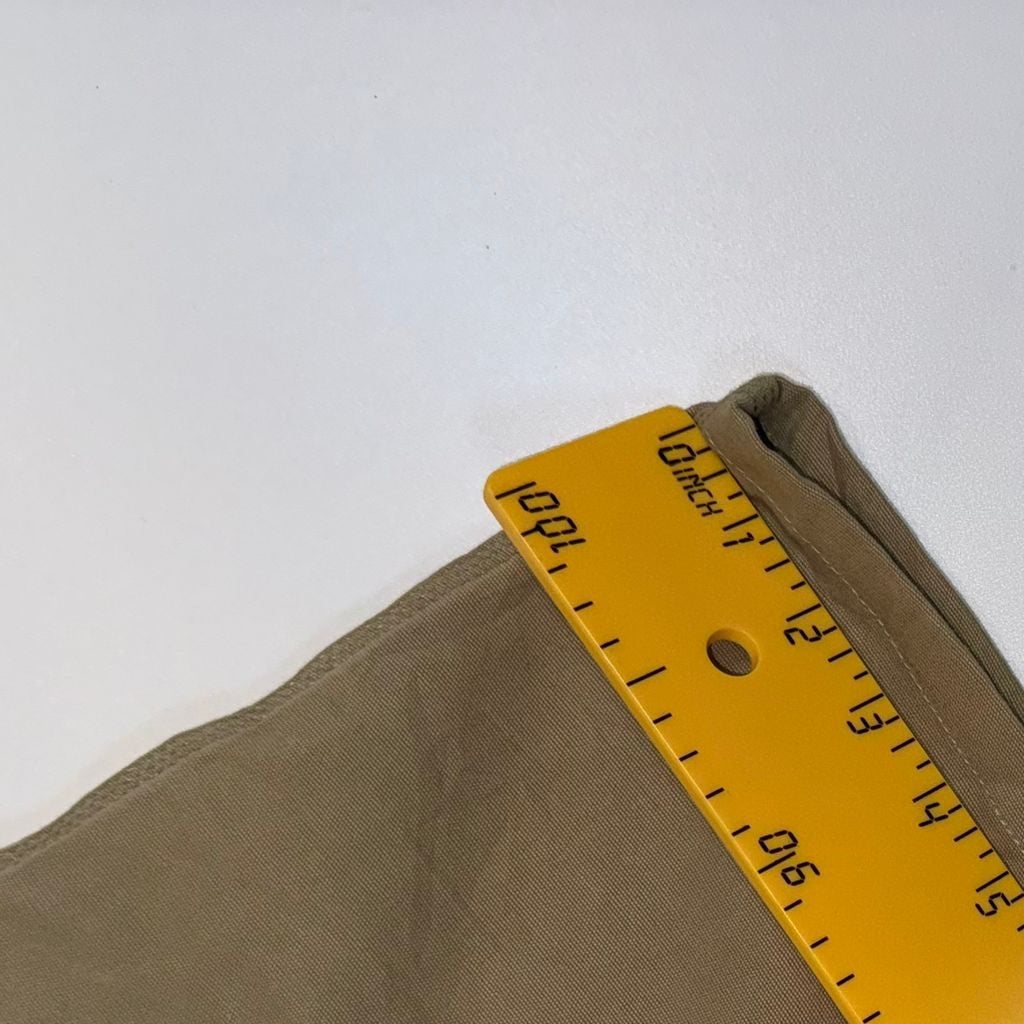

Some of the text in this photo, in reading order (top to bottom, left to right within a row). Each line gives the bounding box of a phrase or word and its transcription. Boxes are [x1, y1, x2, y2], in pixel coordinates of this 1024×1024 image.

[659, 443, 723, 518] 0 INCH
[518, 490, 587, 555] 100
[722, 533, 755, 548] 1
[783, 625, 823, 647] 2
[846, 712, 884, 735] 3
[918, 801, 949, 828] 4
[758, 829, 820, 887] 90
[975, 892, 1012, 917] 5
